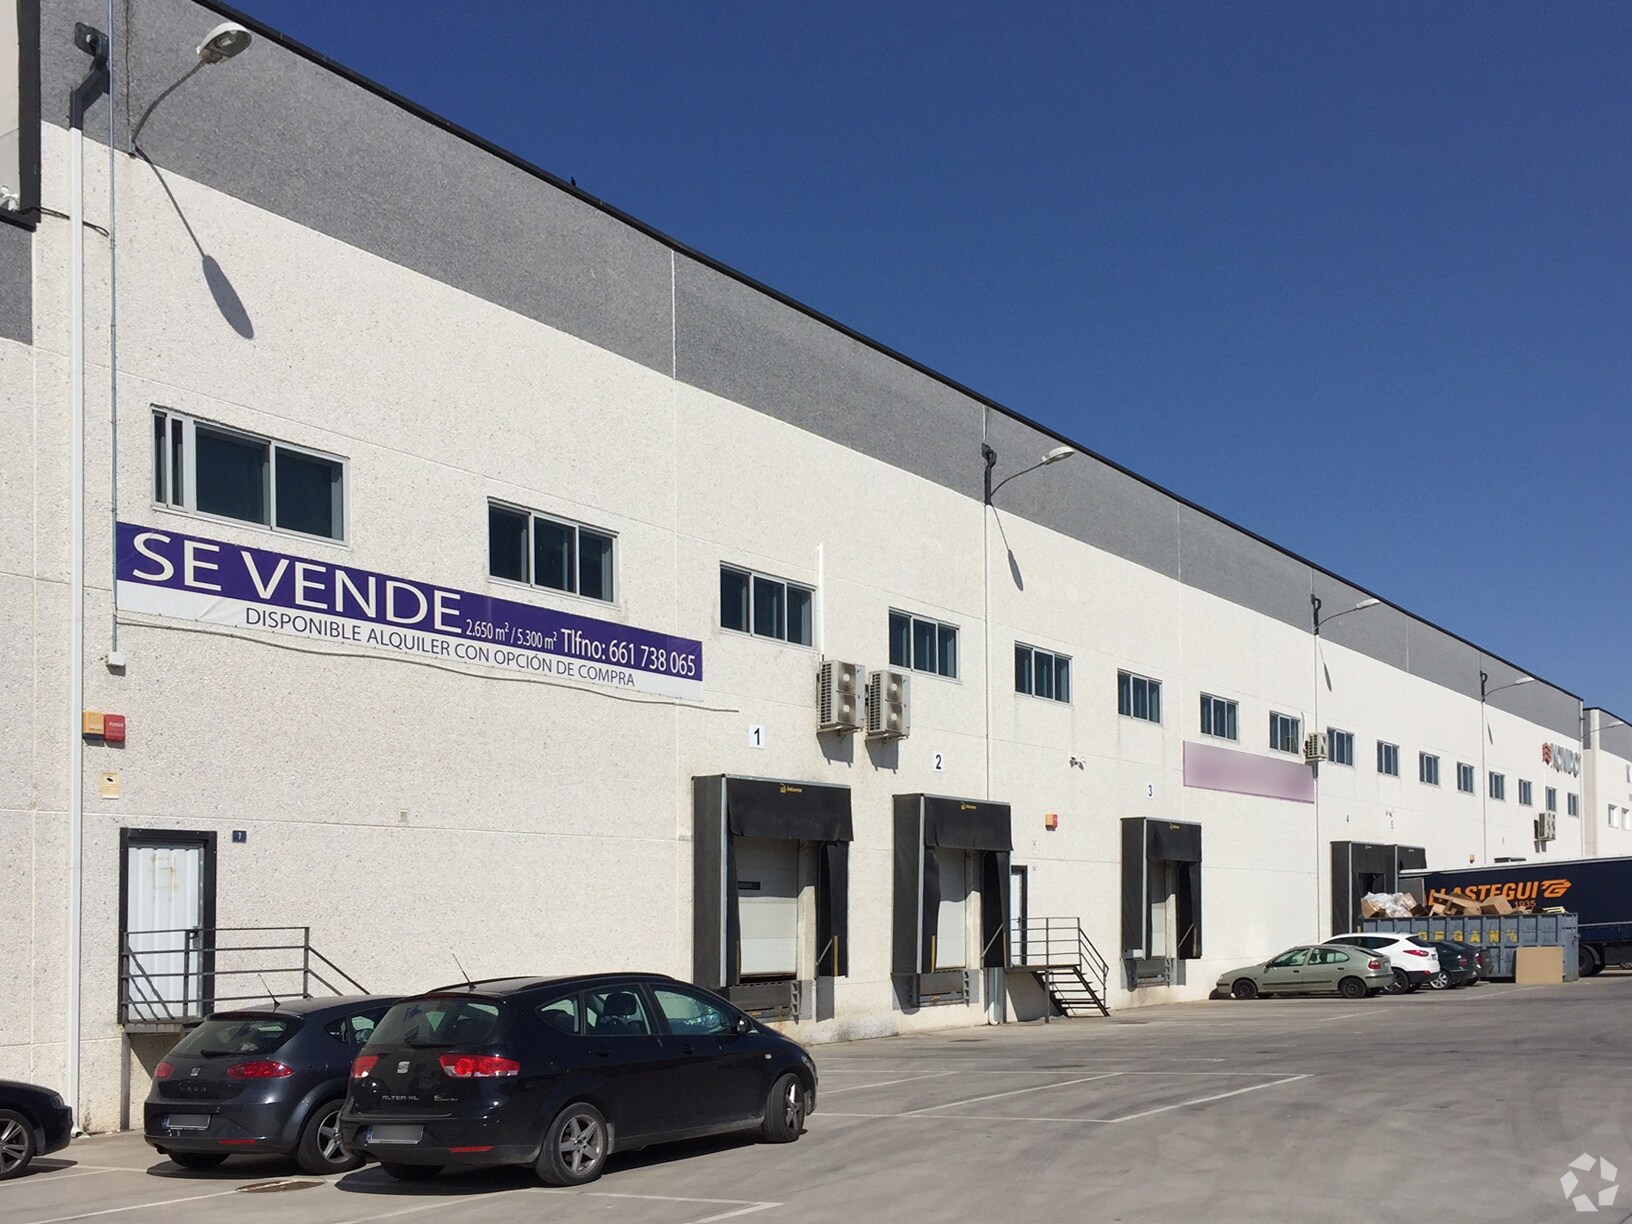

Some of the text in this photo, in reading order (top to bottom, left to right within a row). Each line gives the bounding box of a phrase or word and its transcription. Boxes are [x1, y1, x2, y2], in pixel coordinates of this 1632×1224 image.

[132, 531, 462, 634] SE VENDE
[245, 607, 636, 688] DISPONIBLE ALQUILER CON OPCIÓN DE COMPRA
[465, 618, 494, 640] 2.650
[517, 628, 543, 648] 5.300
[560, 628, 606, 660] Tlfno:
[609, 639, 635, 665] 661
[640, 645, 667, 671] 738
[669, 651, 696, 677] 065
[753, 727, 760, 746] 1
[935, 754, 942, 770] 2
[1147, 784, 1153, 797] 3
